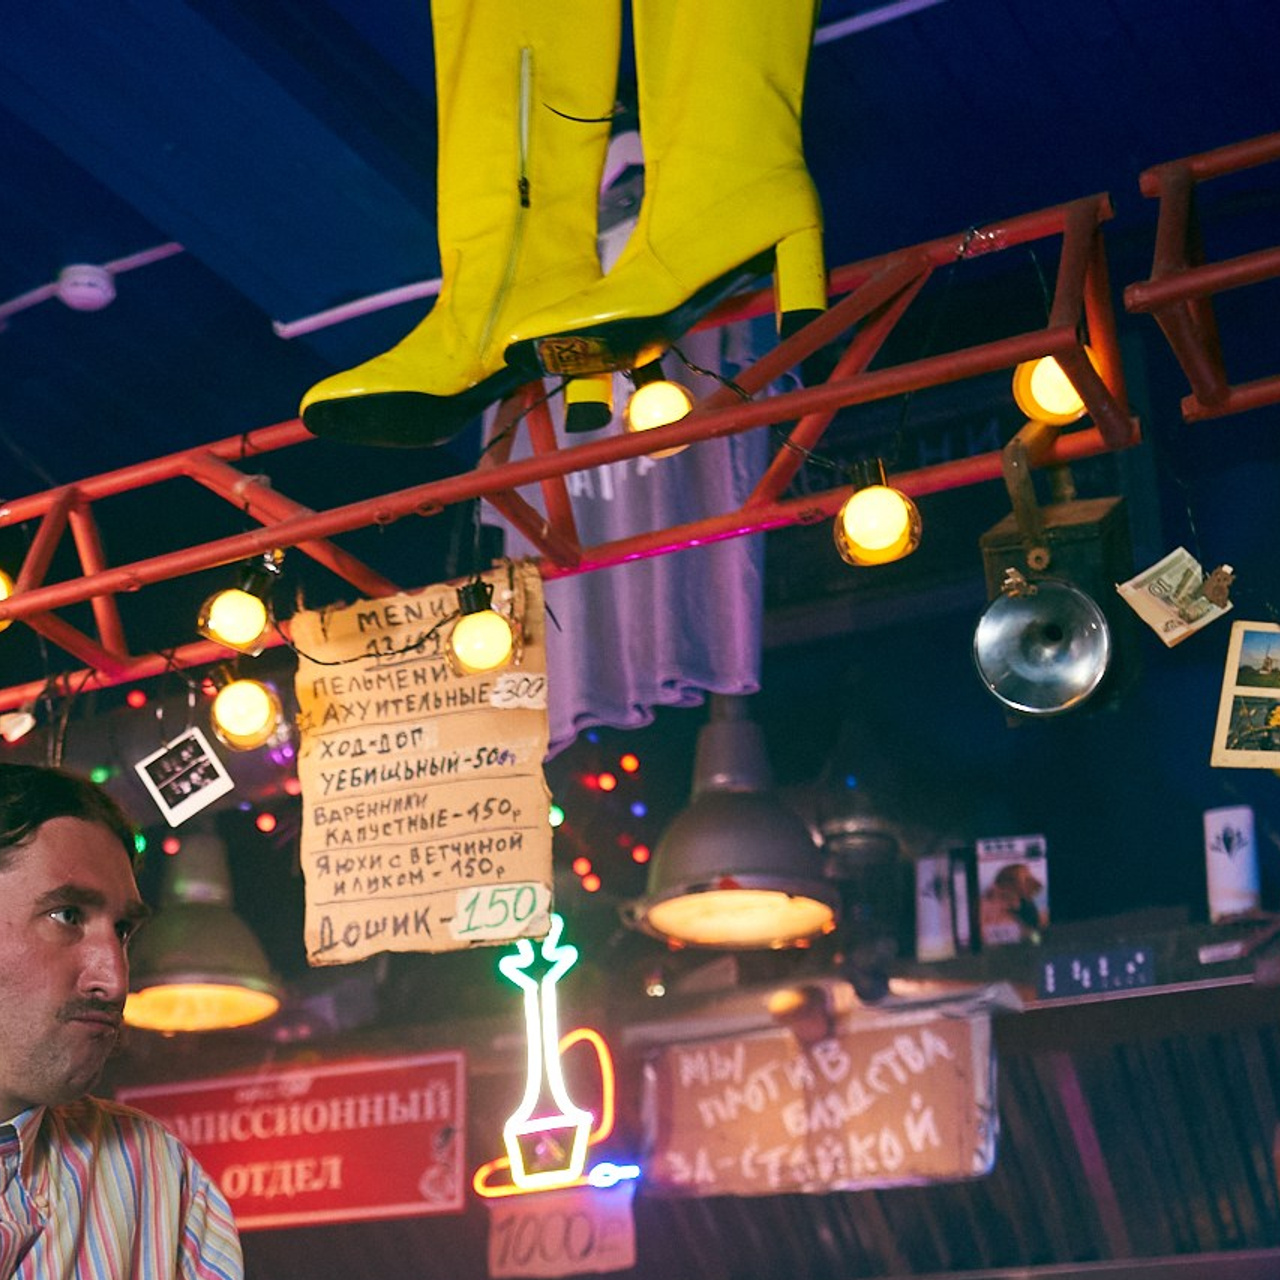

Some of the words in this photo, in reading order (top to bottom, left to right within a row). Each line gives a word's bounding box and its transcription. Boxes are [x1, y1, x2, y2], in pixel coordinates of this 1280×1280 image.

[313, 664, 449, 699] ПЕЛЬМЕНИ
[410, 832, 524, 866] ВЕТЧИНОЙ
[678, 1042, 745, 1088] МЫ
[170, 1079, 452, 1147] МИССИОННЫЙ
[220, 1154, 345, 1200] ОТДЕЛ
